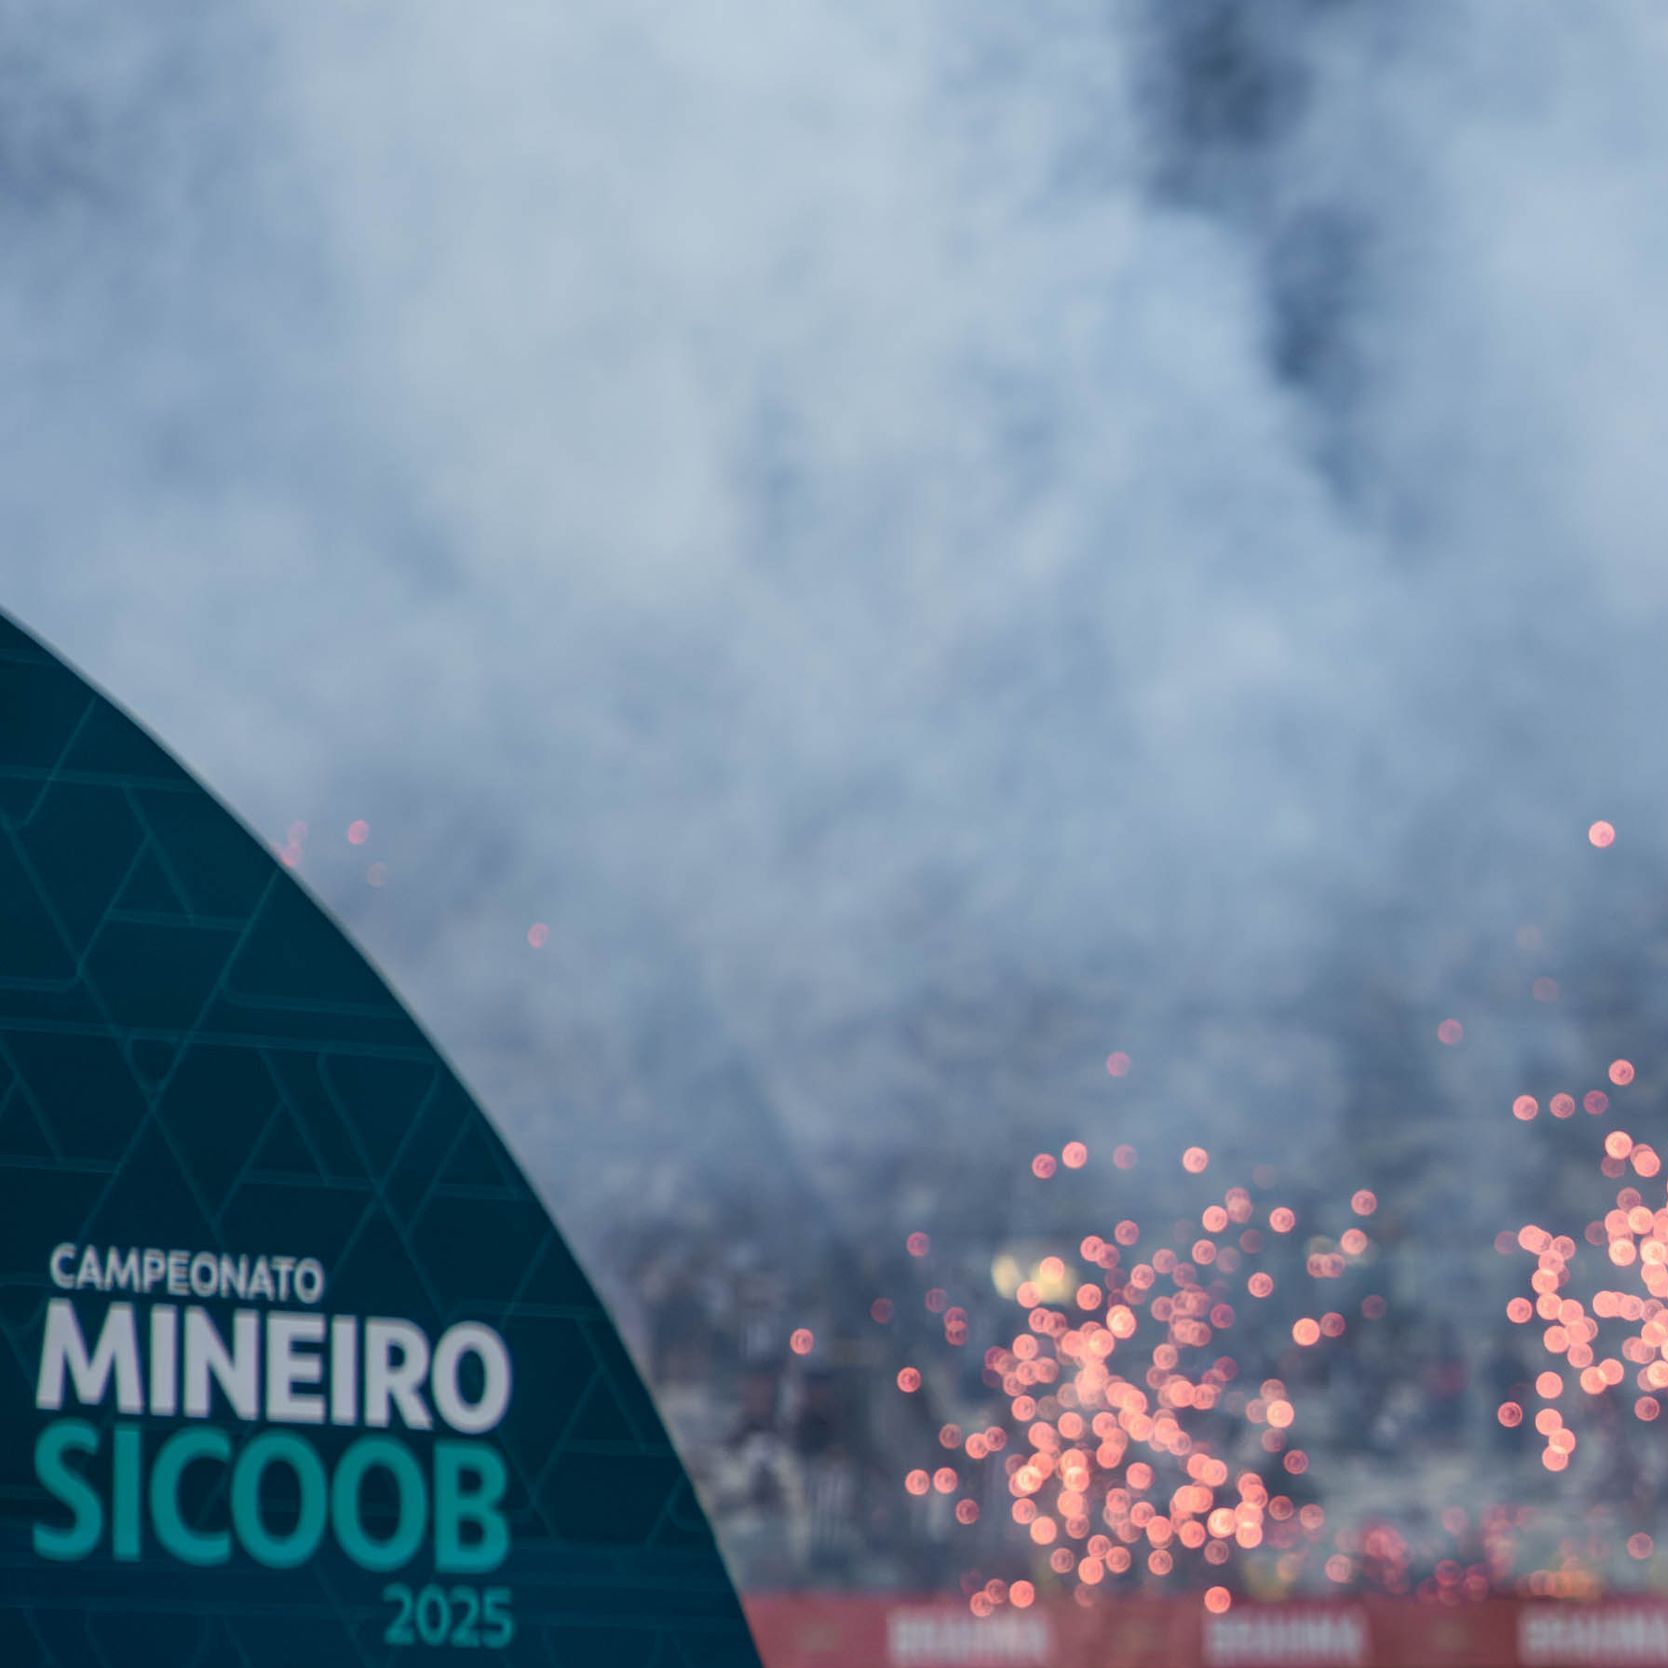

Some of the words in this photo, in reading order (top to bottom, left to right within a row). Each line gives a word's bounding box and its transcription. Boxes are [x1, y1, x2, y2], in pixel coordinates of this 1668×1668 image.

[50, 1242, 324, 1304] CAMPEONATO
[35, 1297, 512, 1434] MINEIRO
[33, 1418, 510, 1574] SICOOB
[383, 1583, 514, 1649] 2025
